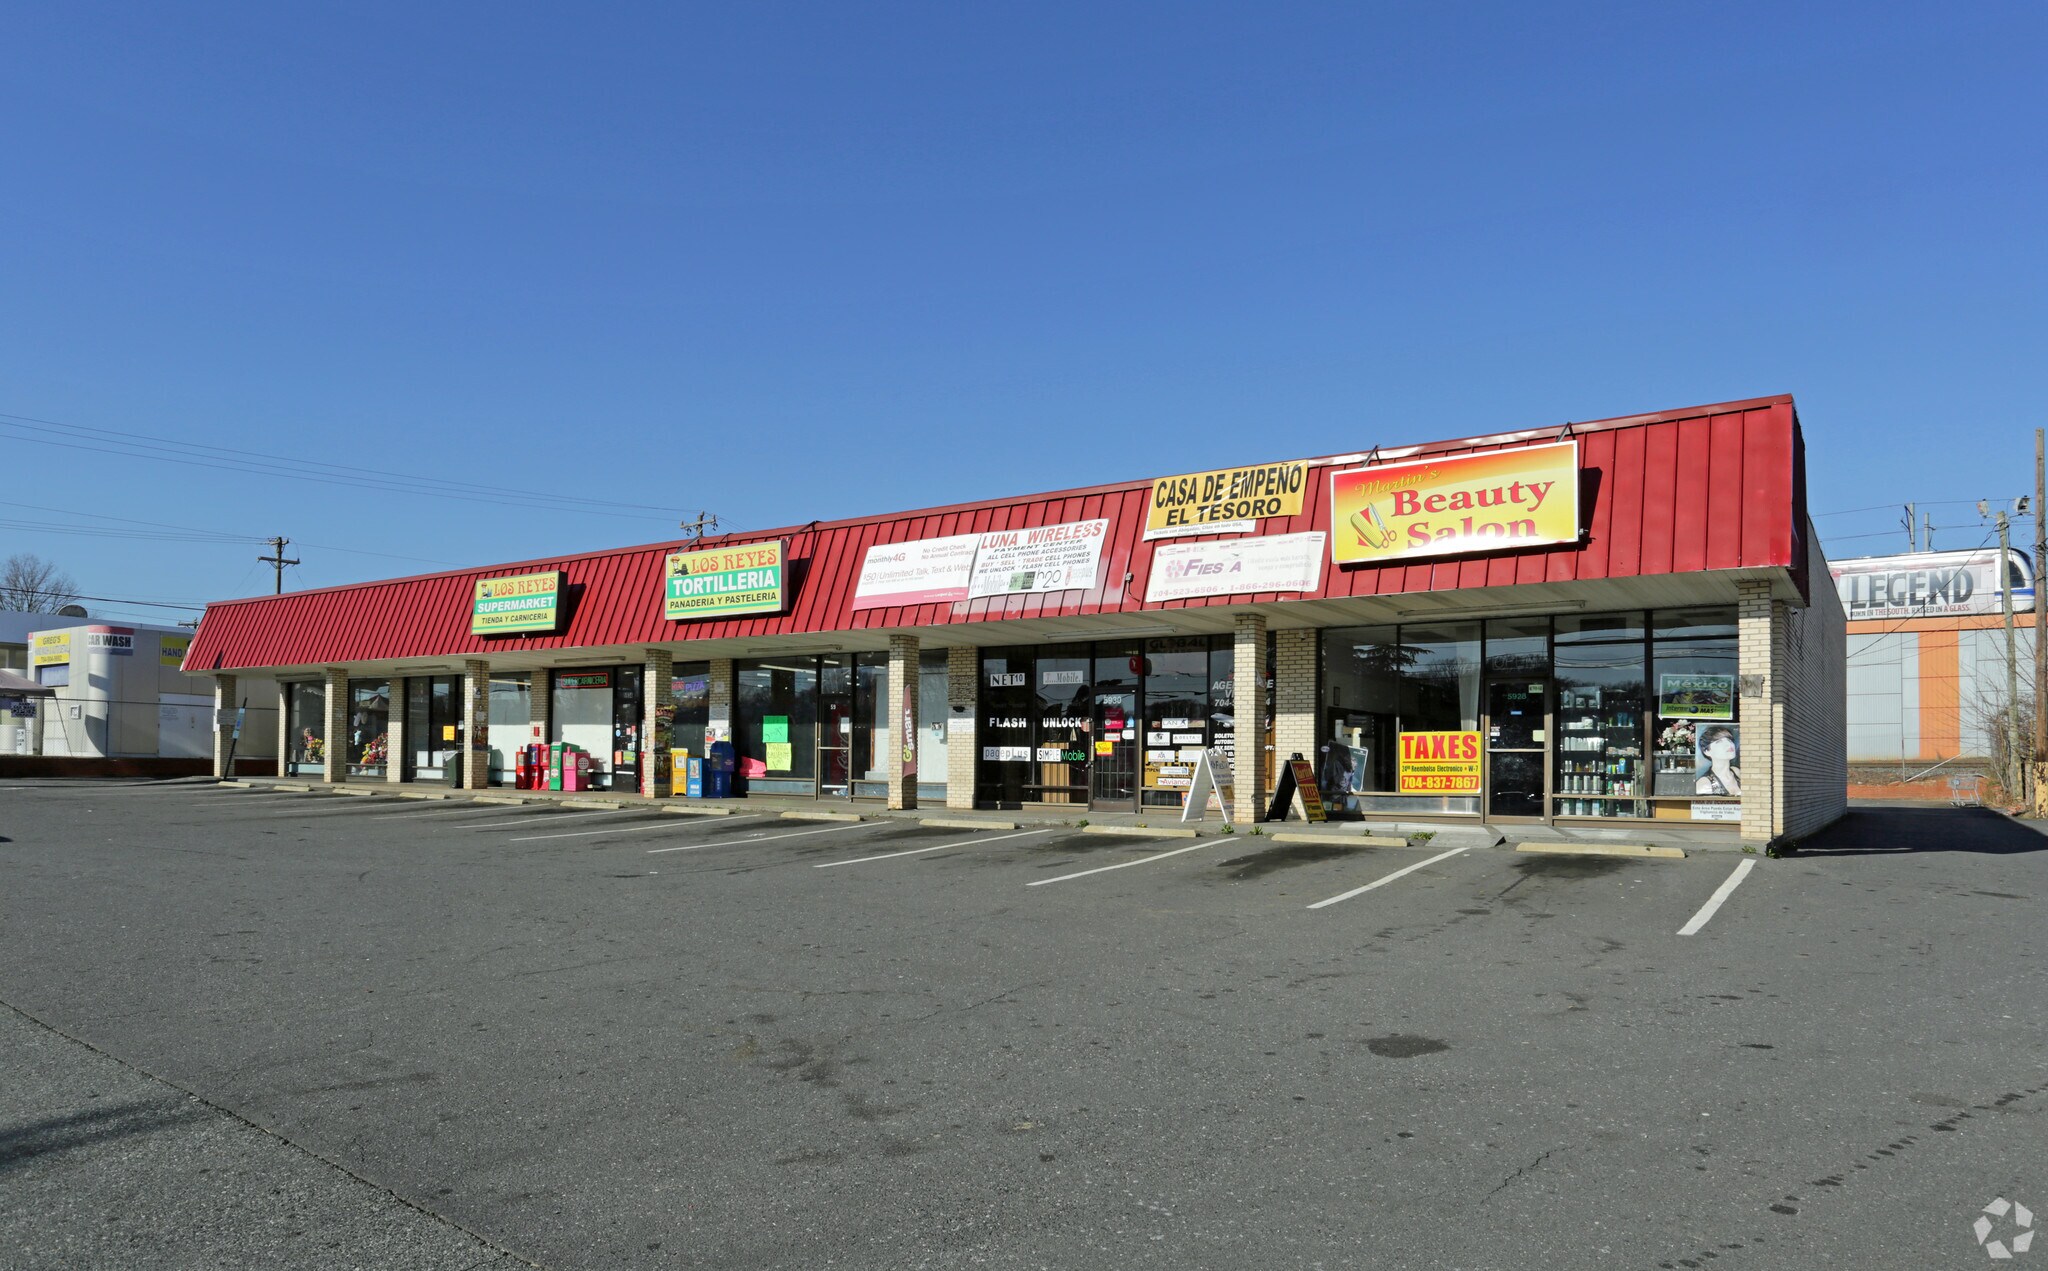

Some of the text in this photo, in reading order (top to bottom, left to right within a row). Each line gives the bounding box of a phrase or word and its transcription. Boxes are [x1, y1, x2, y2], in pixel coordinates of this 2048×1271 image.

[1156, 462, 1302, 507] CASA DE EMPEÑO
[1355, 466, 1440, 497] Martin's
[1391, 480, 1555, 517] Beauty
[1166, 498, 1281, 525] EL TESORO
[981, 522, 1103, 549] LUNA WIRELESS
[1406, 516, 1539, 549] Salon
[949, 543, 966, 551] Check
[994, 539, 1083, 553] PAYMENT CENTER
[1041, 544, 1087, 555] ACCESSORIES
[691, 549, 777, 574] LOS REYES
[1063, 551, 1091, 559] PHONES
[990, 565, 1015, 573] UNLOCK
[1062, 558, 1090, 566] PHONES
[879, 568, 914, 580] Unlimited
[494, 577, 556, 597] LOS REYES
[673, 569, 775, 596] TORTILLERIA
[1851, 569, 1974, 609] LEGEND
[478, 597, 554, 613] SUPERMARKET
[669, 591, 777, 609] PANADERIA Y PASTELERIA
[482, 612, 548, 624] TIENDA Y CARNICERIA
[1875, 608, 1887, 616] THE
[102, 635, 131, 647] WASH
[162, 648, 182, 657] HAND
[1667, 679, 1728, 689] México
[1507, 692, 1527, 700] 5928
[989, 717, 1082, 728] FLASH UNLOCK
[1401, 734, 1477, 760] TAXES
[1061, 749, 1086, 761] Mobile
[1402, 776, 1477, 789] 704-837-7867
